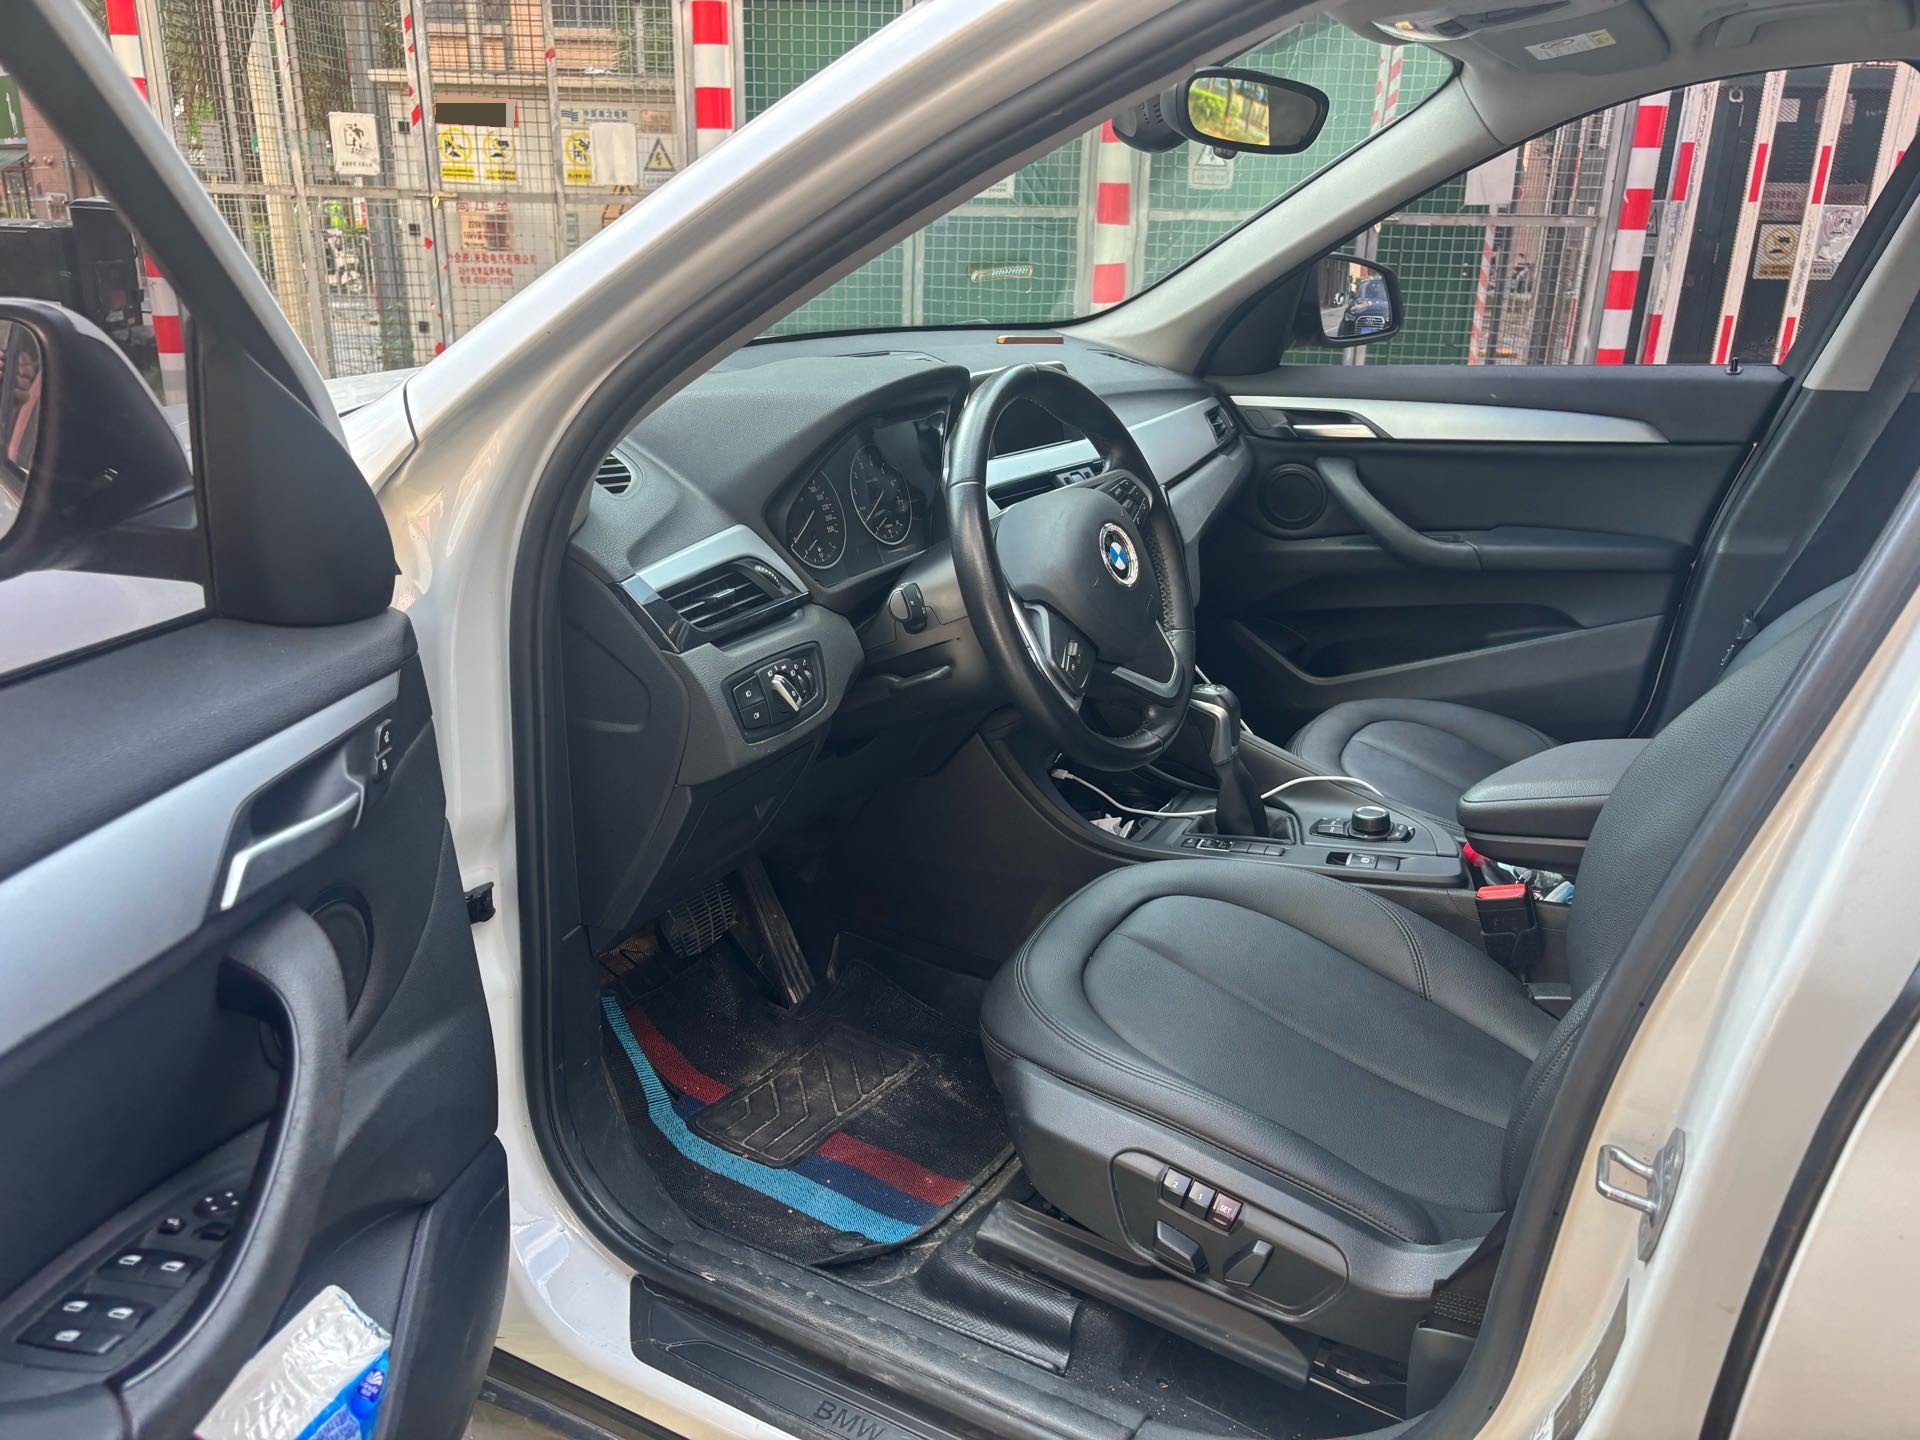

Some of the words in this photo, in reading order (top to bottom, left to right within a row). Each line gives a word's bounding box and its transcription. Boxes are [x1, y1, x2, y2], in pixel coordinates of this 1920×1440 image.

[1172, 1181, 1179, 1189] 2
[1219, 1204, 1232, 1214] SET
[813, 1400, 886, 1440] BMW
